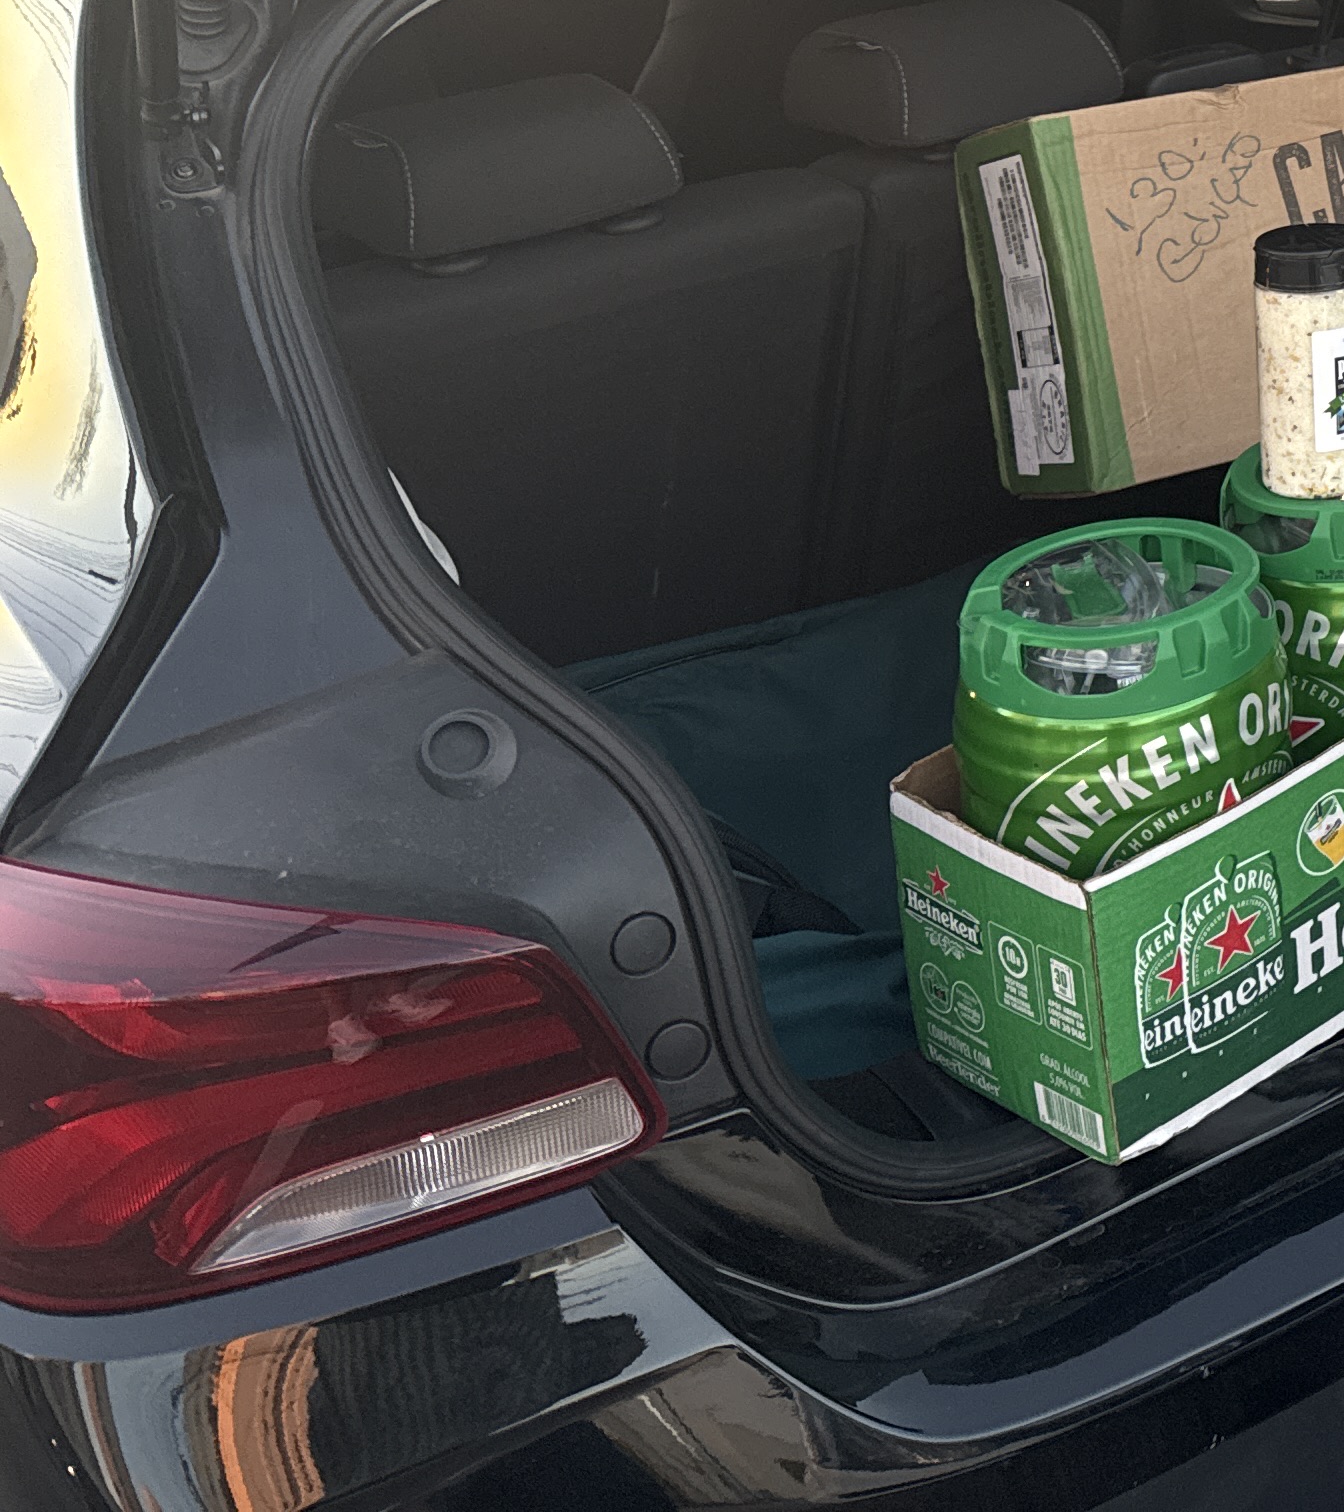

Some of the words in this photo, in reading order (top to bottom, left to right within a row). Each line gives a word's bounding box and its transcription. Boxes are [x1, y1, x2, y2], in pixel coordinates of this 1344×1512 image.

[1024, 713, 1221, 871] INEKEN
[906, 886, 979, 945] Heineken
[1053, 967, 1068, 989] 30
